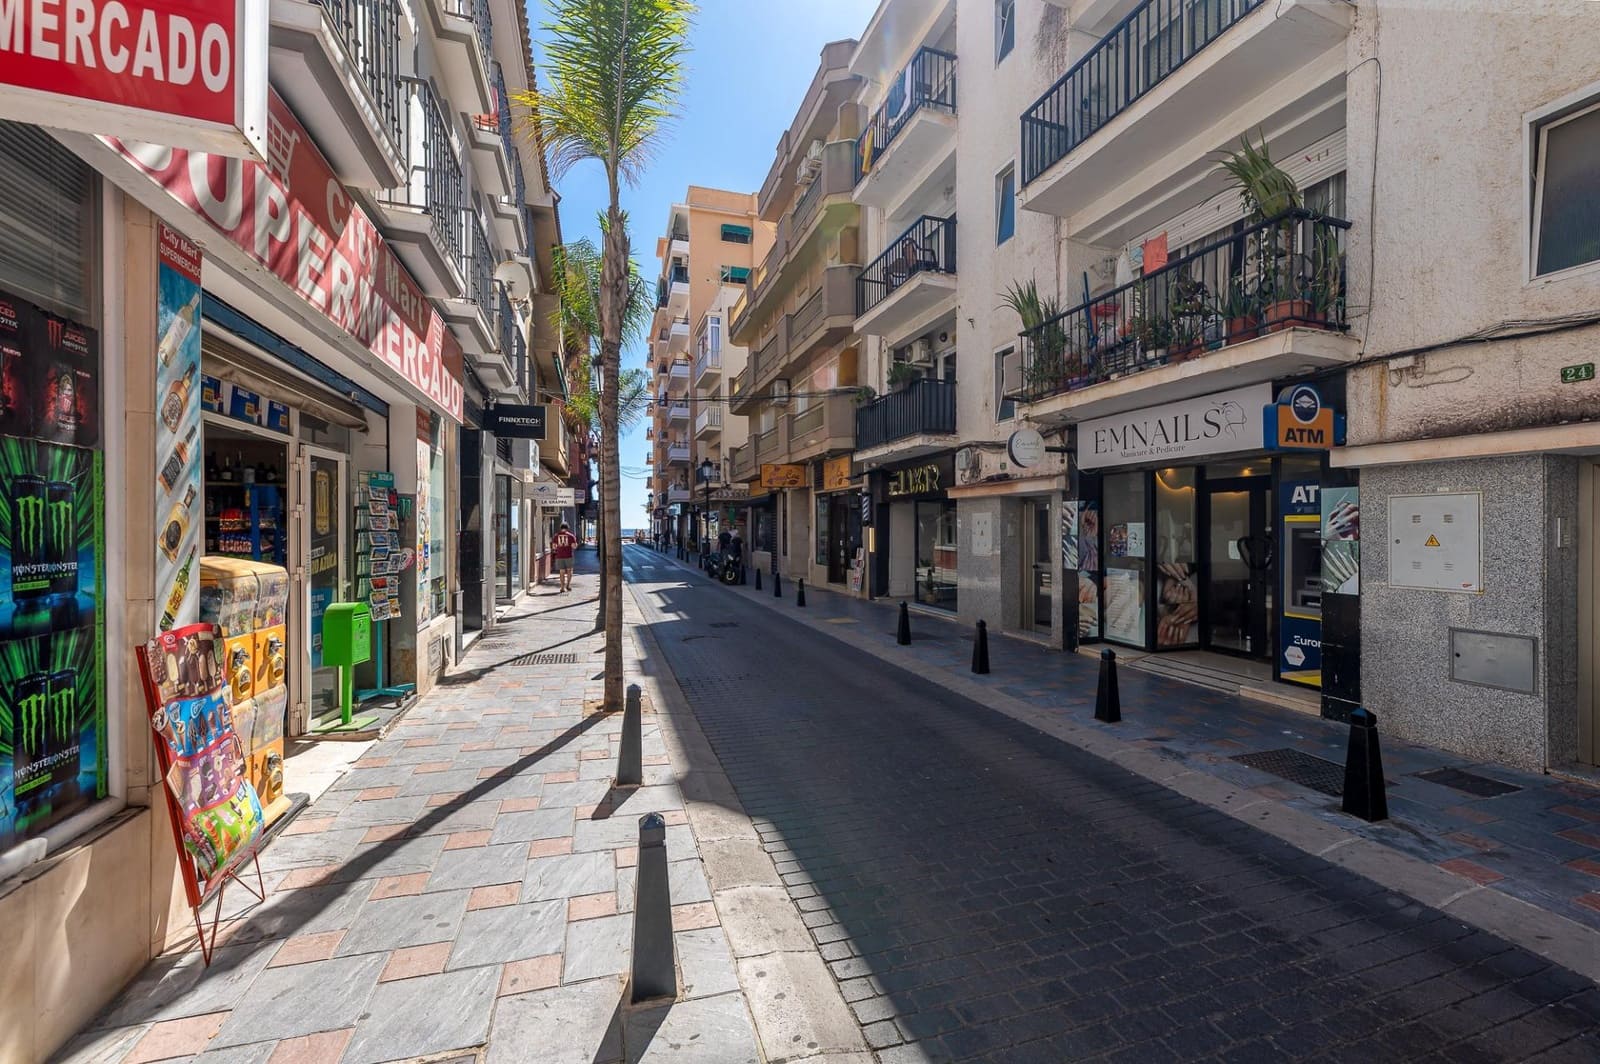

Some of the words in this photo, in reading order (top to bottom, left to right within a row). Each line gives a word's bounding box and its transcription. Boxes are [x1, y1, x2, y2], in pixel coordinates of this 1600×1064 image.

[0, 0, 230, 93] MERCADO
[163, 226, 179, 249] City
[180, 239, 198, 260] Mart
[326, 178, 383, 286] City
[385, 250, 424, 332] Mart
[122, 142, 460, 416] UPERMERCADO
[1566, 366, 1587, 380] 24
[1094, 408, 1221, 455] EMNAILS
[1156, 444, 1186, 454] Pedicure
[1284, 428, 1324, 444] ATM
